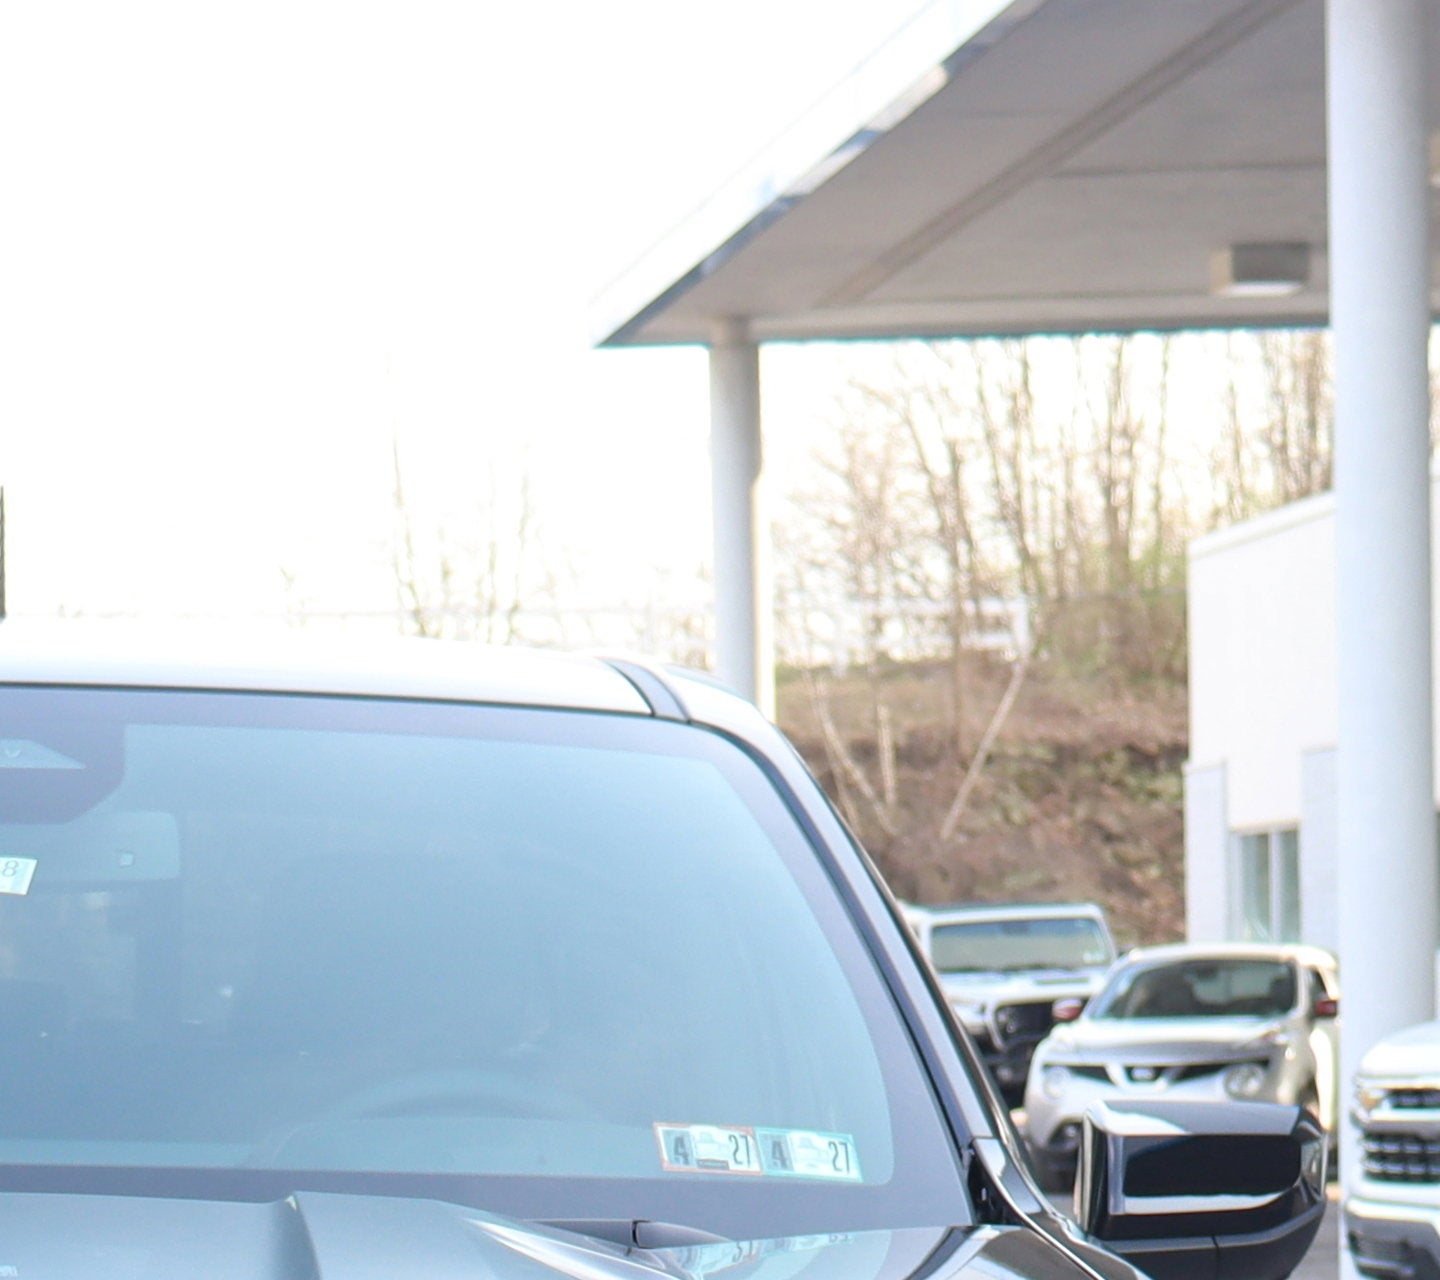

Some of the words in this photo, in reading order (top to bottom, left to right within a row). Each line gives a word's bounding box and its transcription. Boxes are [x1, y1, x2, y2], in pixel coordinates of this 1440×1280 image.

[673, 1135, 691, 1167] 4
[728, 1134, 752, 1168] 27
[771, 1139, 789, 1170] 4
[827, 1140, 851, 1174] 27
